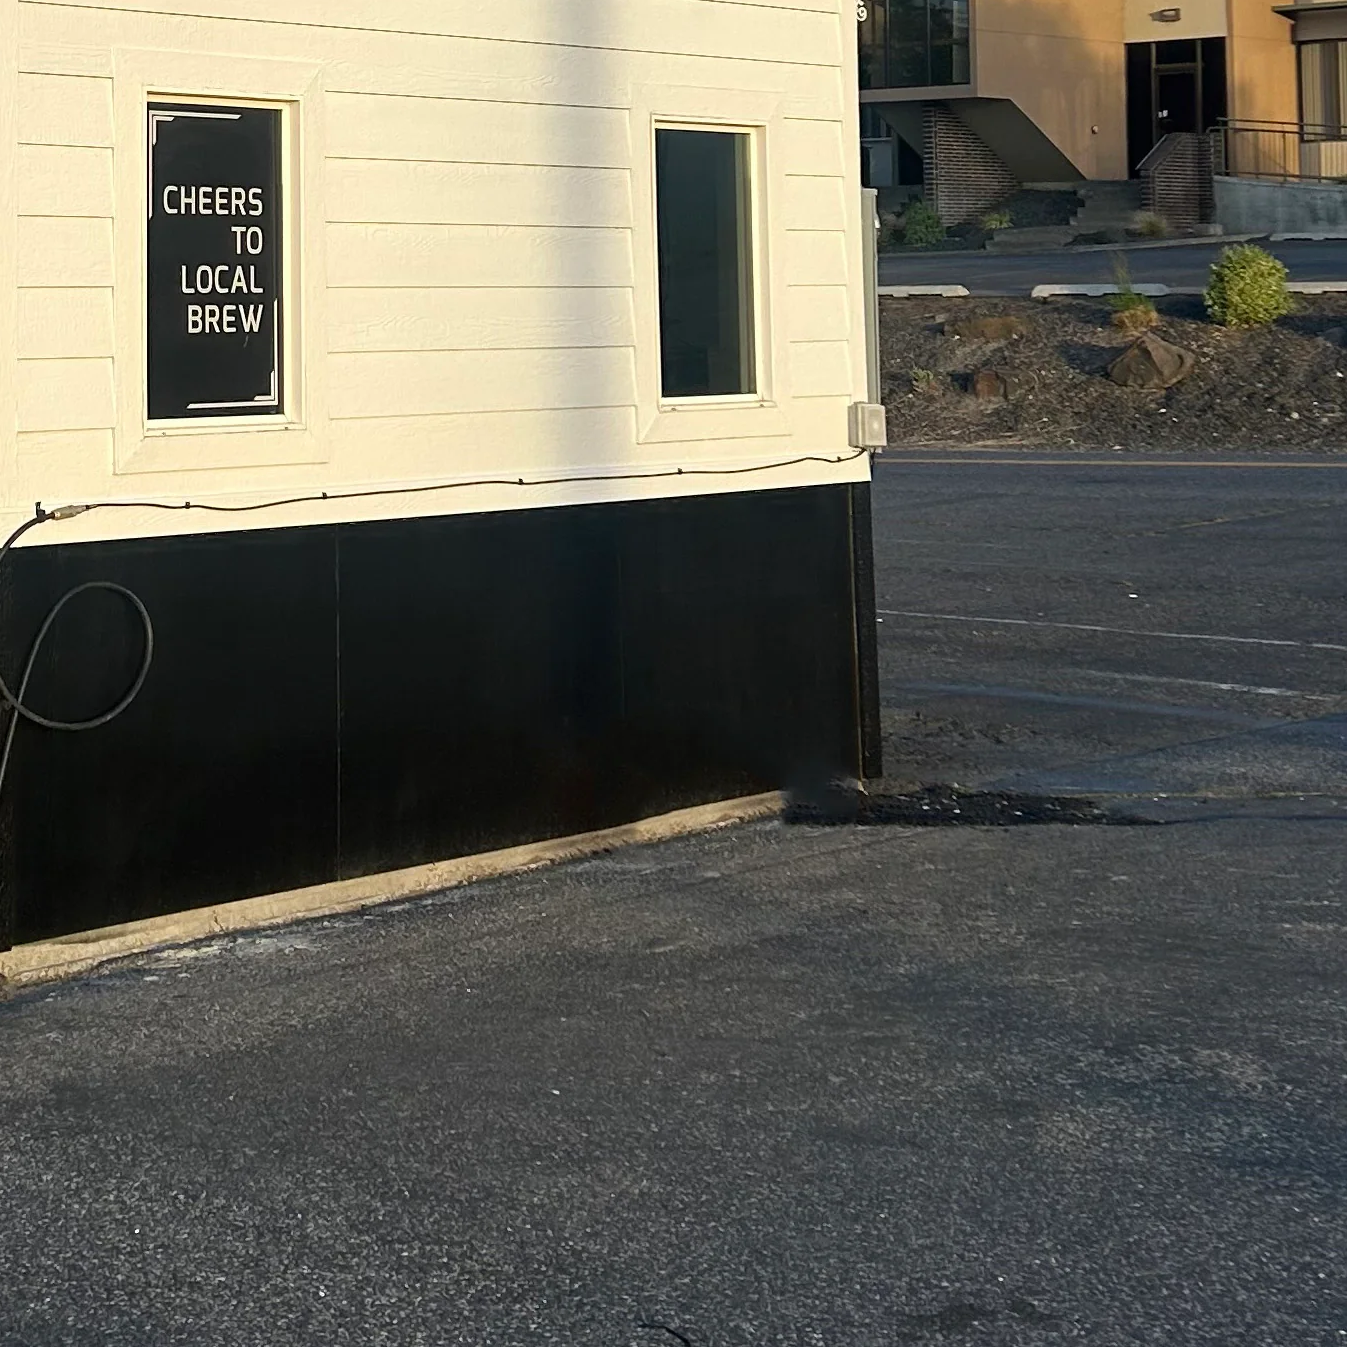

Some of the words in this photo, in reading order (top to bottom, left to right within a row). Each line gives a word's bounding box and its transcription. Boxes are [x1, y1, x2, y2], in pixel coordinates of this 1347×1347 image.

[162, 185, 264, 217] CHEERS
[231, 225, 264, 255] TO
[180, 264, 264, 294] LOCAL
[187, 303, 264, 334] BREW
